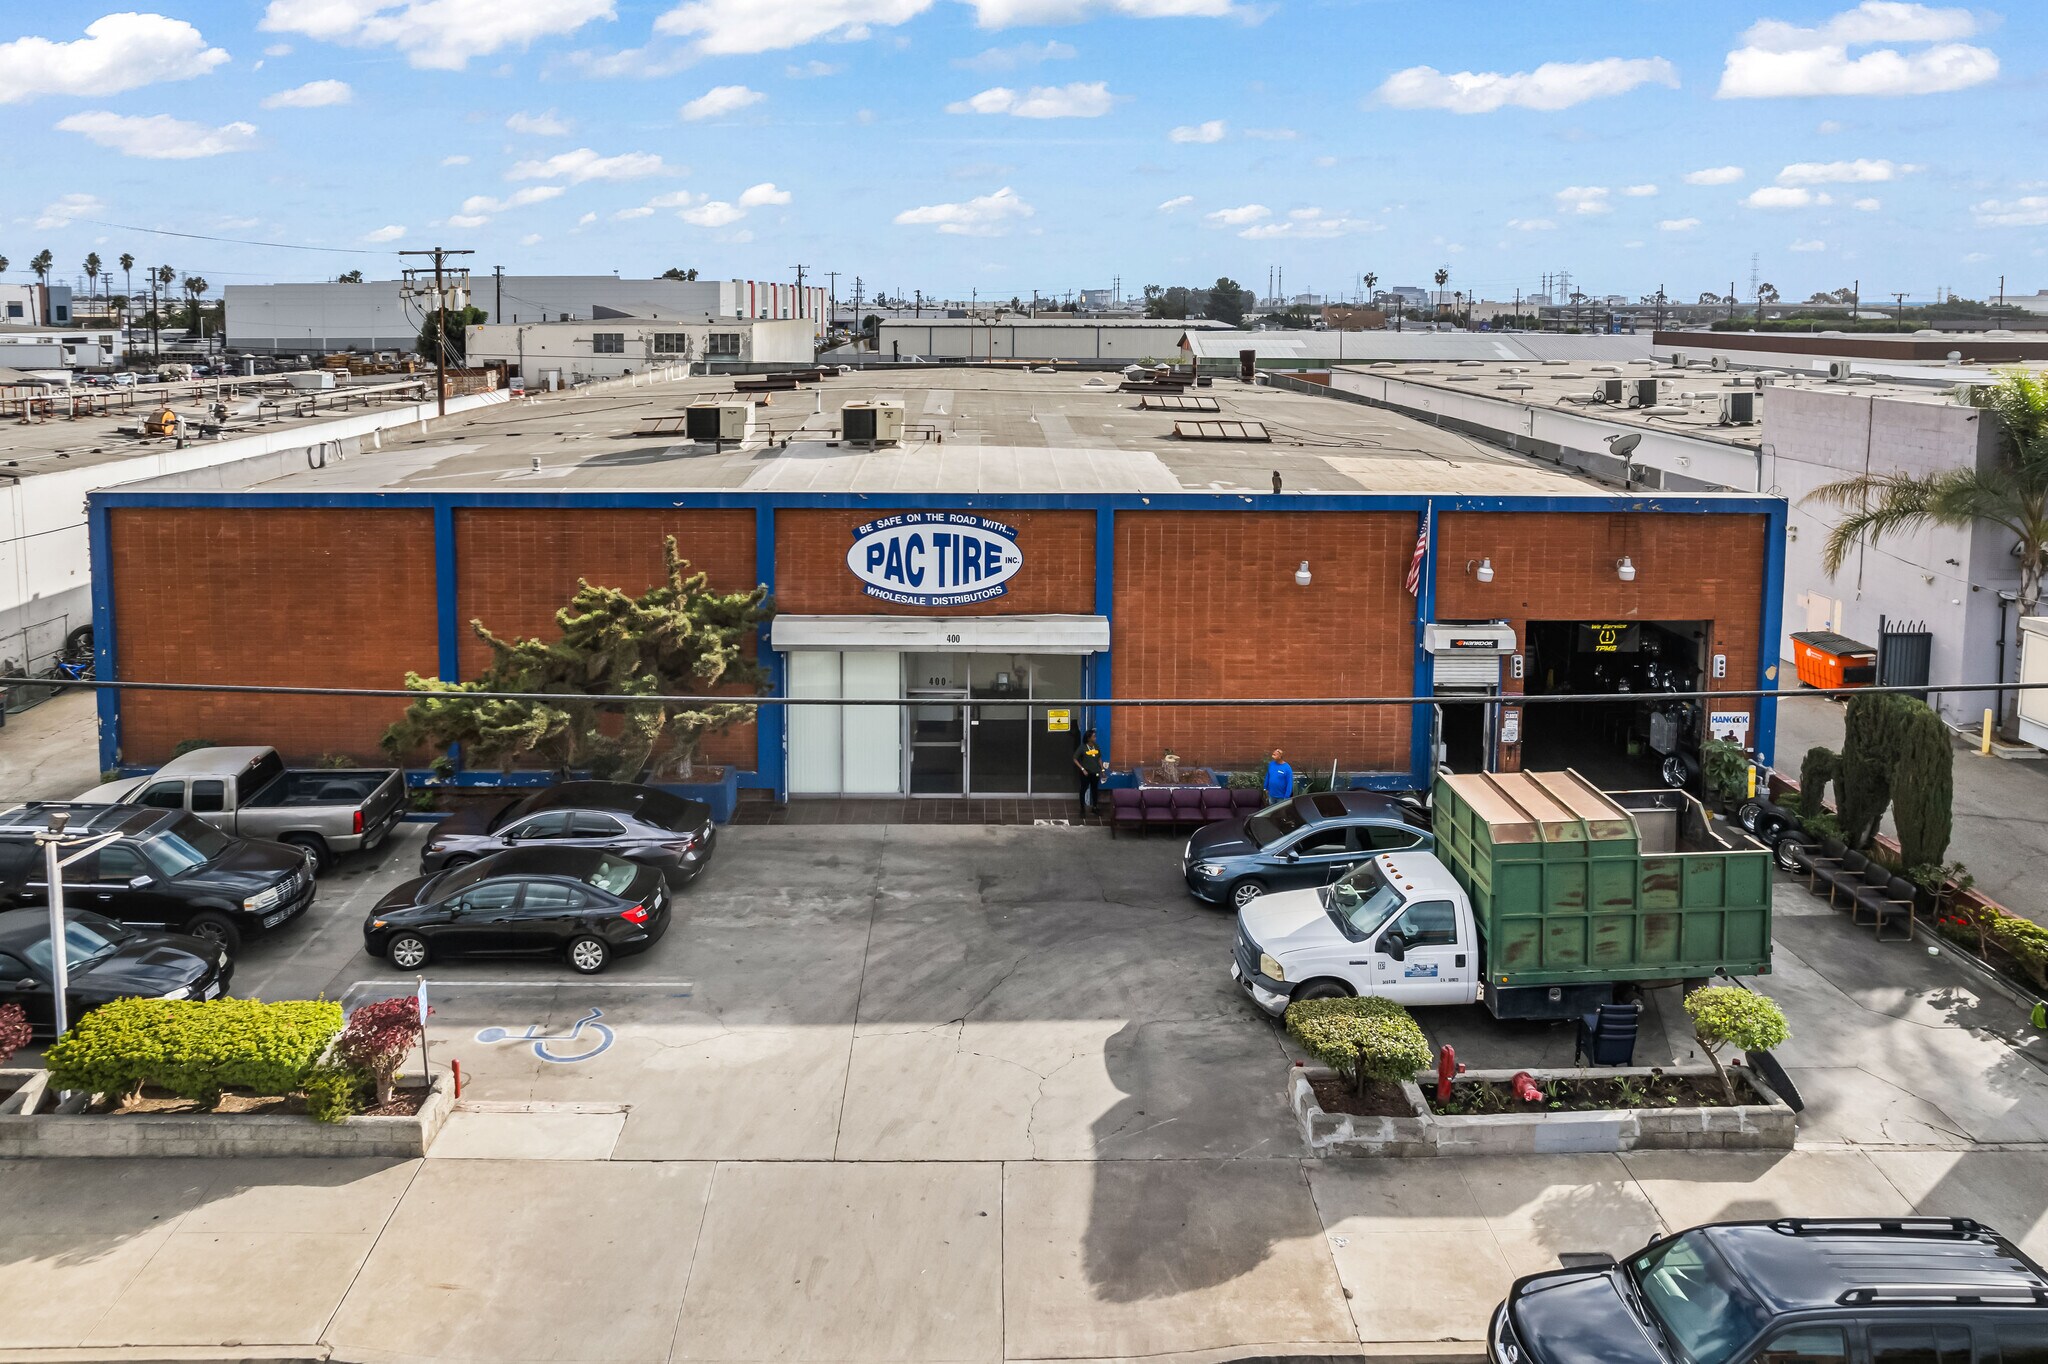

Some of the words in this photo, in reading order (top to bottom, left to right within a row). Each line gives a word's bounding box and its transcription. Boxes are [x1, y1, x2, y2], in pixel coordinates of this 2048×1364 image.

[859, 523, 873, 535] BE
[877, 515, 903, 529] SAFE
[906, 513, 921, 523] ON
[925, 513, 945, 522] THE
[949, 513, 977, 526] ROAD
[866, 532, 926, 588] PAC
[932, 532, 1003, 588] TIRE
[1004, 556, 1020, 564] INC.
[866, 585, 926, 605] WHOLESALE
[932, 585, 1003, 605] DISTRIBUTORS
[946, 634, 961, 643] 400
[928, 677, 947, 686] 400
[1711, 715, 1749, 724] HANKOOK
